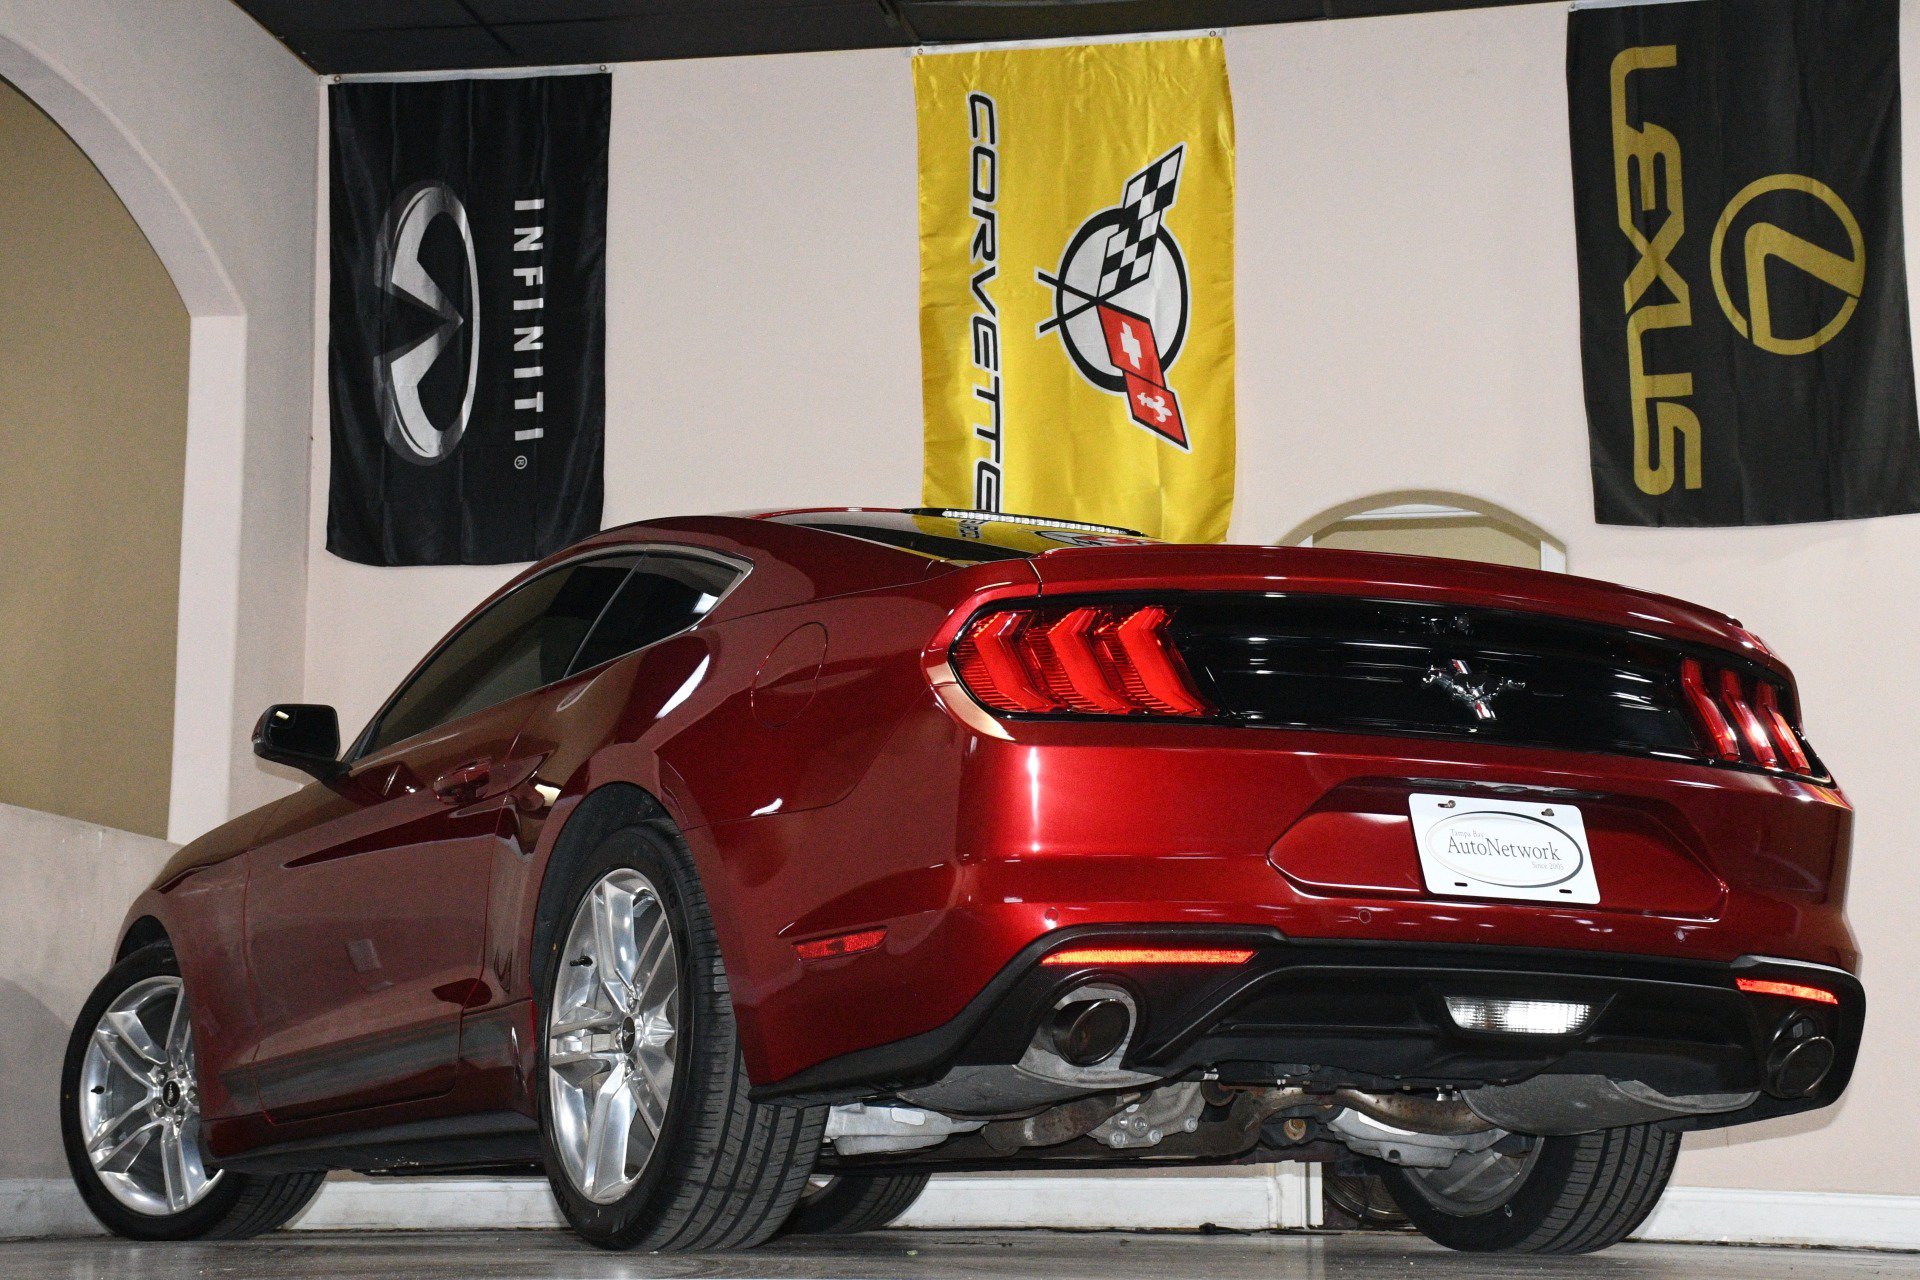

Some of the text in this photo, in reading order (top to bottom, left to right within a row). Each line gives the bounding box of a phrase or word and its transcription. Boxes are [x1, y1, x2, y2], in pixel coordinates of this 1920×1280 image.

[512, 198, 545, 441] INFINITI
[967, 91, 1001, 513] CORVETTE
[1610, 44, 1702, 496] LEXUS
[1448, 836, 1562, 861] AutoNetwork
[1450, 828, 1471, 839] Tampa
